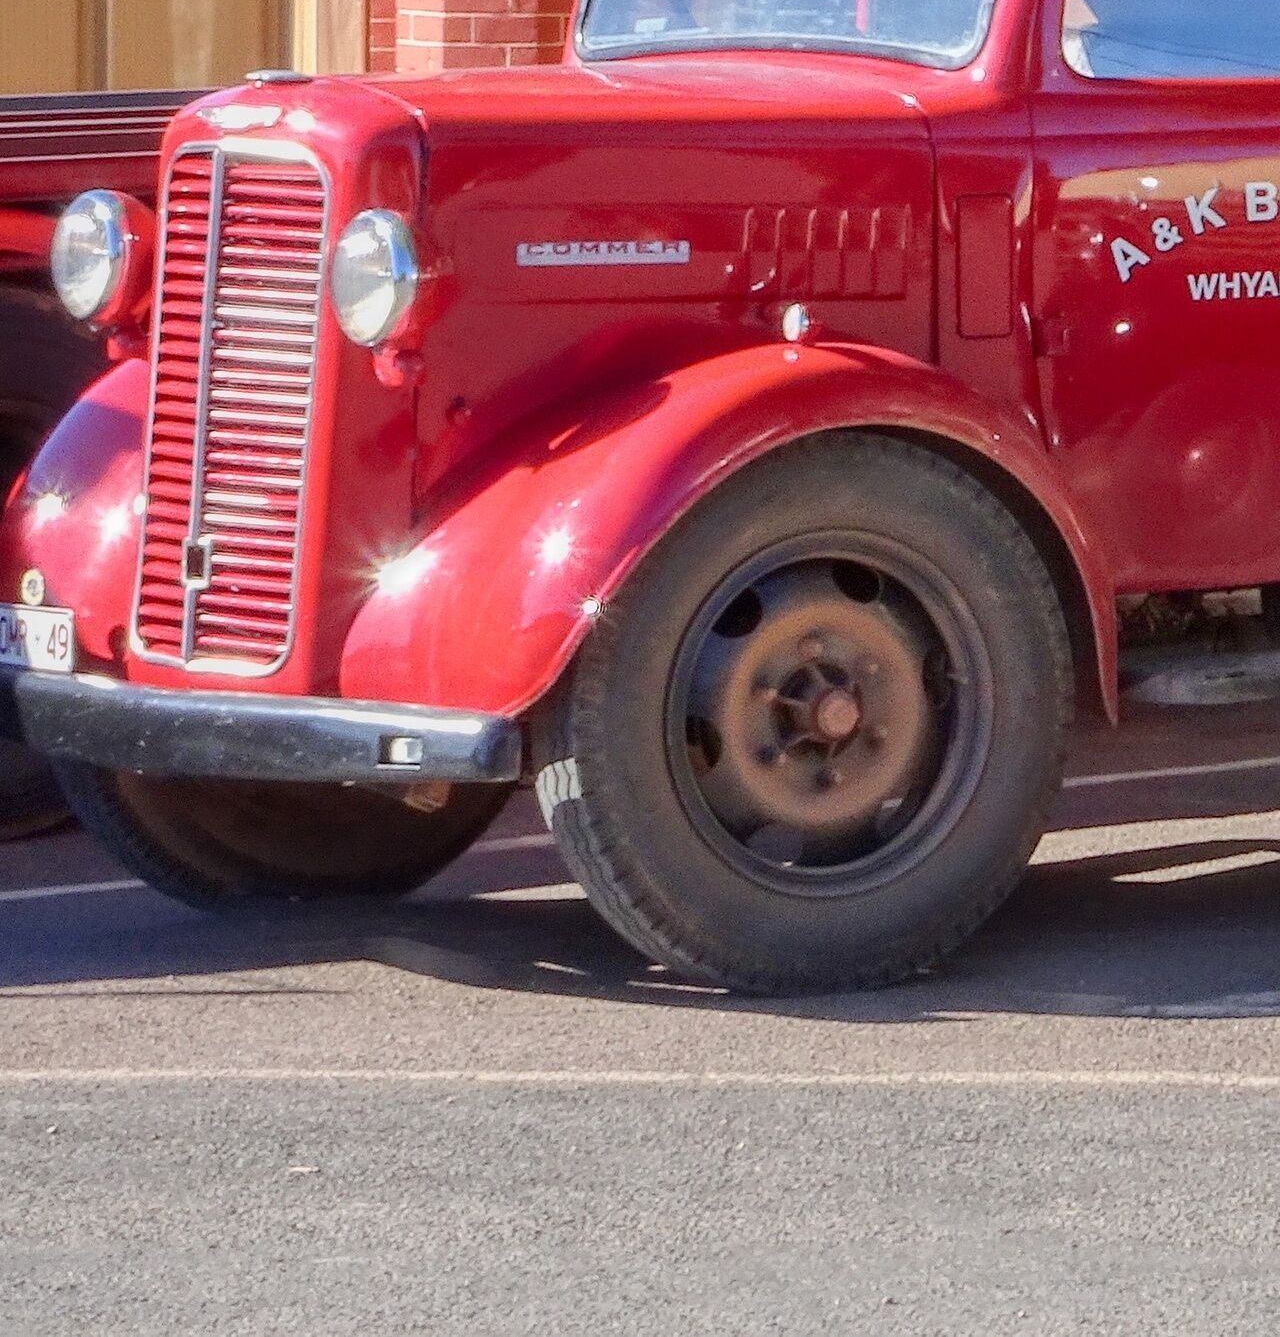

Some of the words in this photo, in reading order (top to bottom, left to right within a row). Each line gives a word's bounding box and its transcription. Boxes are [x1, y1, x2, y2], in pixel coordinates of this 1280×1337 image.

[1110, 236, 1151, 283] A
[1152, 217, 1184, 253] &
[1184, 183, 1228, 235] K
[46, 622, 68, 660] 49
